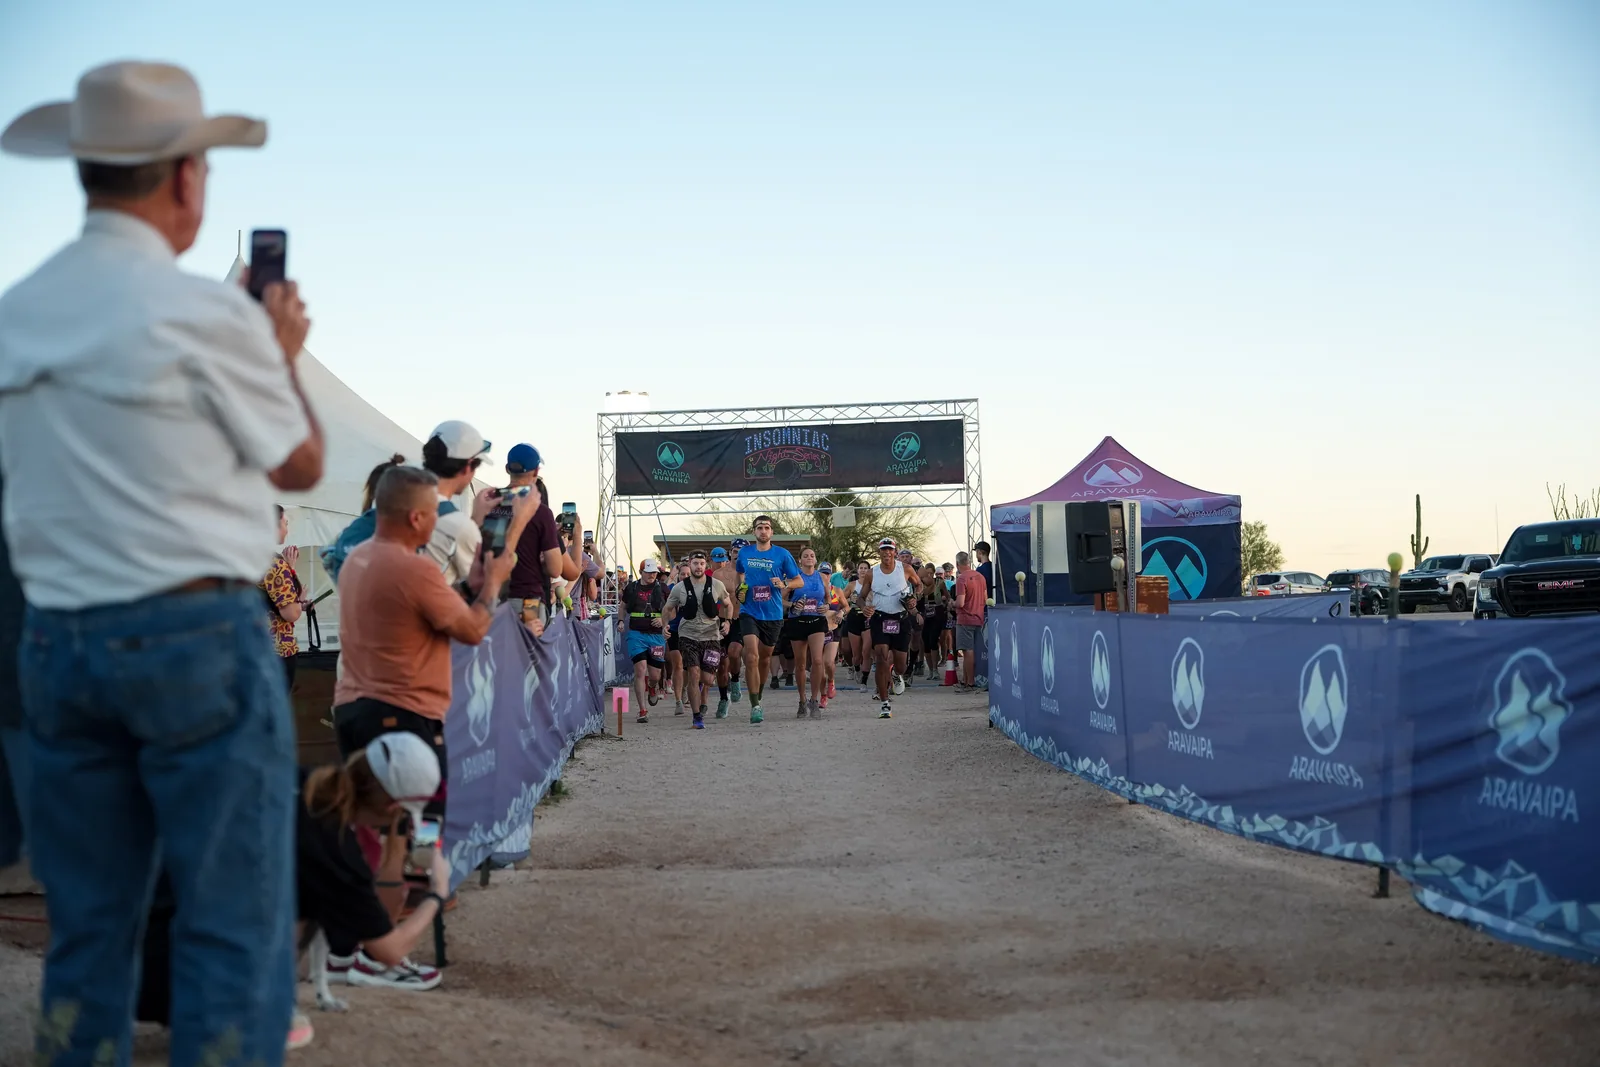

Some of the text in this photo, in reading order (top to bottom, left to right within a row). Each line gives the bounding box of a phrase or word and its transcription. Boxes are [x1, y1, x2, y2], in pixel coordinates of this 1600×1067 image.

[745, 427, 830, 455] INSOMNIAC
[752, 447, 822, 468] Night Series
[886, 458, 928, 473] ARAVAIPA
[895, 467, 919, 476] RIDES
[651, 468, 691, 480] ARAVAIPA
[654, 474, 689, 484] RUNNING
[1071, 487, 1158, 498] ARAVAIPA
[1187, 508, 1233, 518] ARAVAIPA
[747, 560, 773, 569] FOOTHILLS
[1537, 579, 1585, 591] GMC
[1089, 710, 1118, 735] ARAVAIPA
[1167, 730, 1214, 760] ARAVAIPA
[1289, 755, 1364, 790] ARAVAIPA
[1478, 776, 1580, 823] ARAVAIPA
